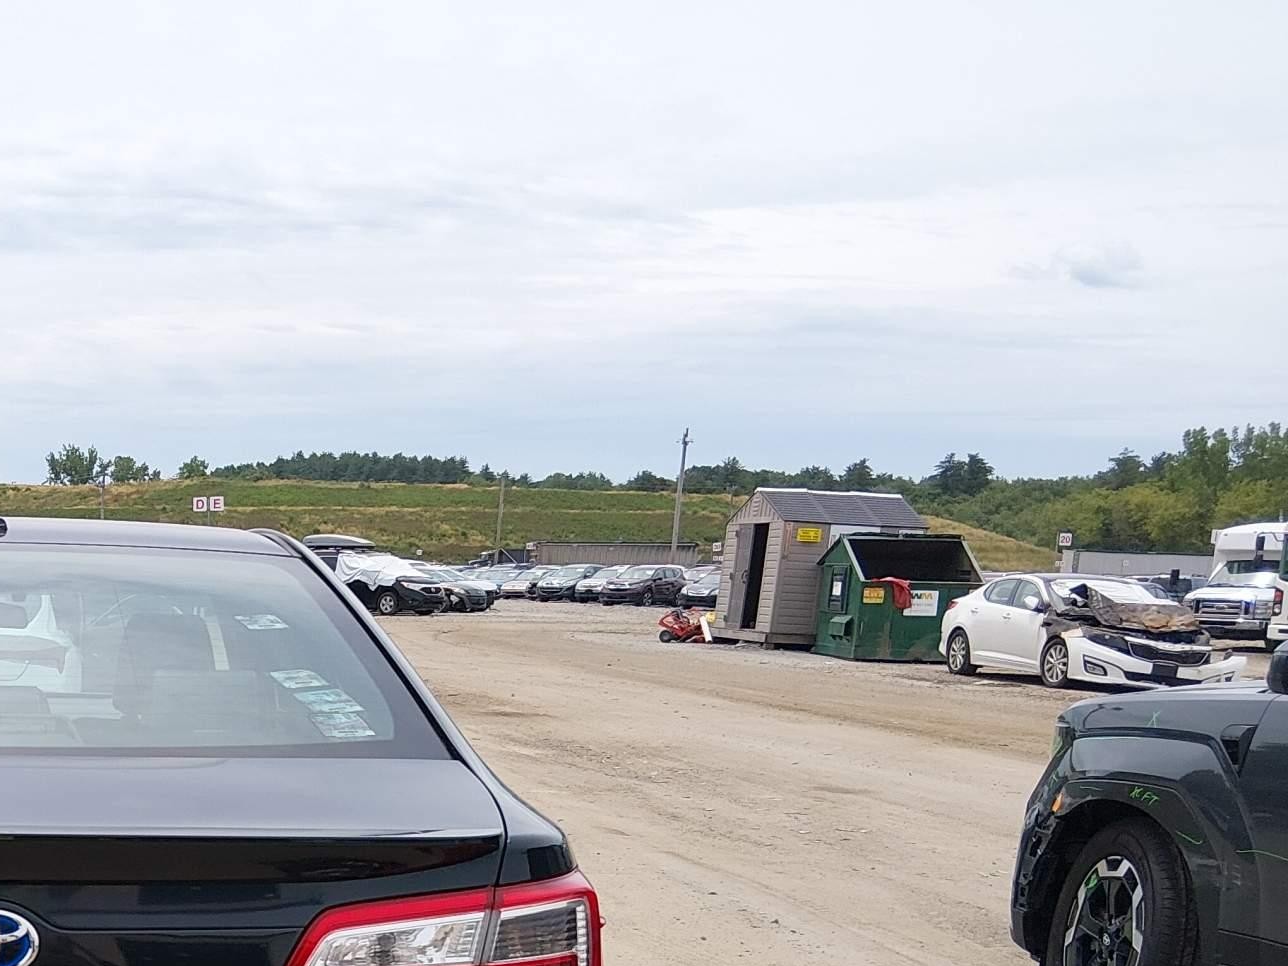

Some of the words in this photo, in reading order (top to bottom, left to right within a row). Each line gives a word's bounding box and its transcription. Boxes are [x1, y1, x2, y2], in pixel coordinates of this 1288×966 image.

[196, 499, 205, 509] D
[213, 499, 221, 509] E
[1060, 535, 1071, 544] 20
